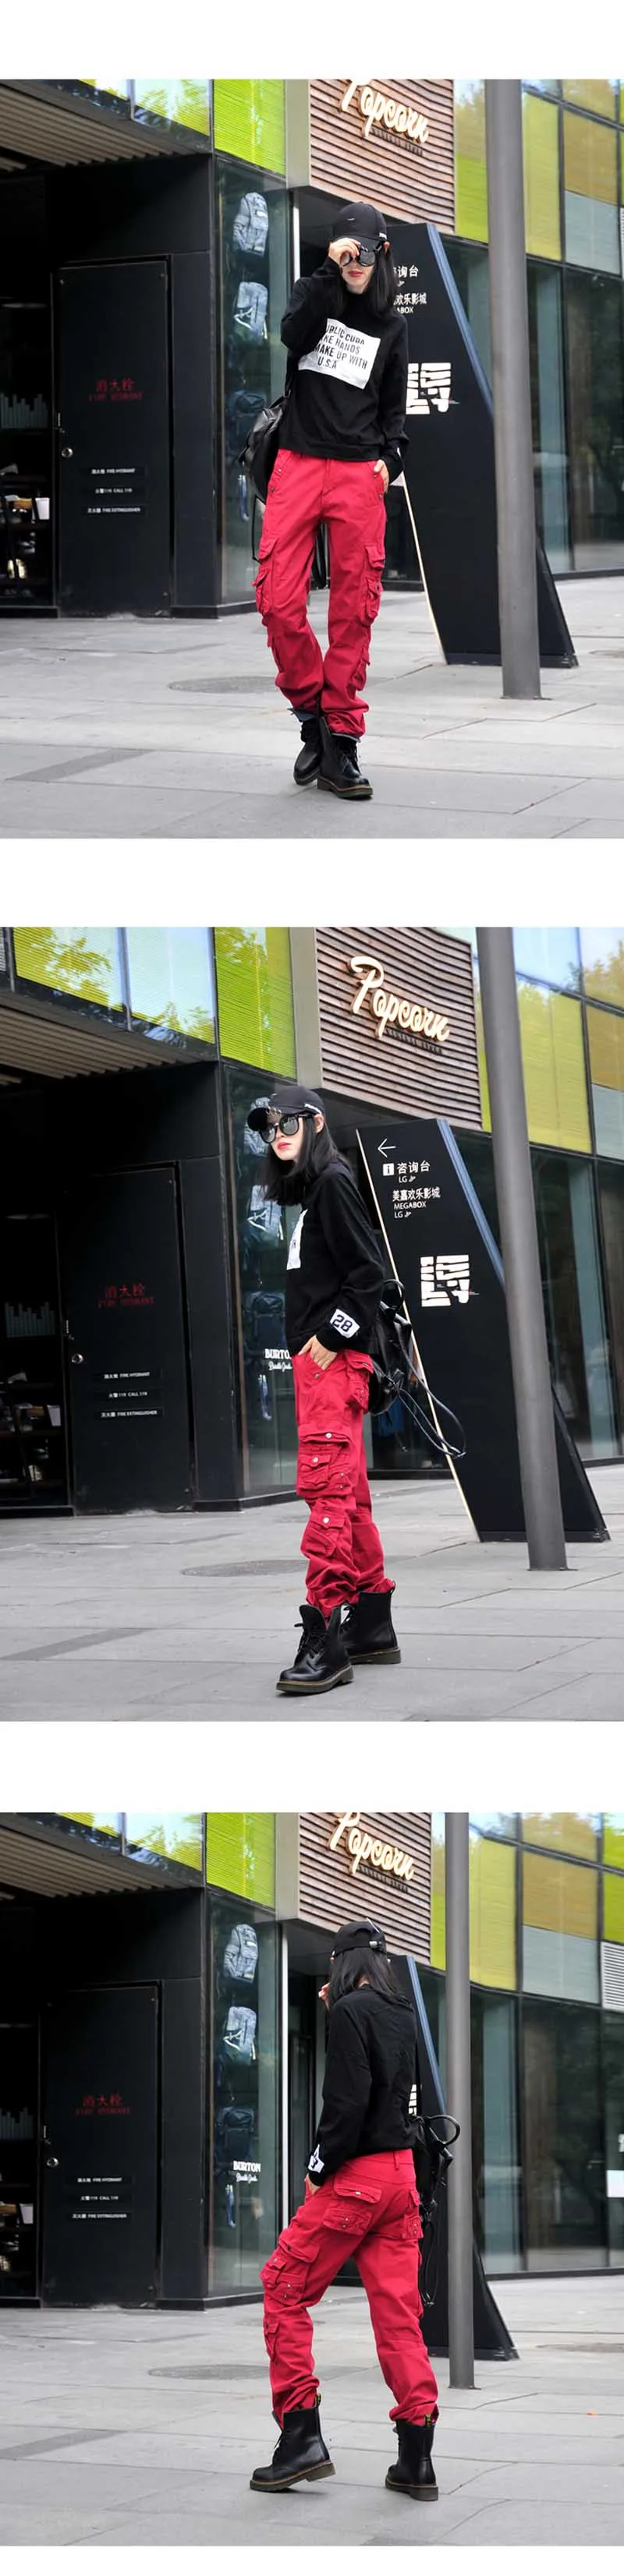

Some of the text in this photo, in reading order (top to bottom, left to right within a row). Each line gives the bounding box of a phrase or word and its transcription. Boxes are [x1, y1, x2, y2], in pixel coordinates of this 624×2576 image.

[393, 265, 419, 277] 询台
[394, 293, 427, 305] 欢乐影城
[335, 338, 361, 355] HANDS
[336, 352, 348, 361] UP
[349, 355, 368, 369] WITH
[351, 956, 450, 1041] Popcorn
[397, 1160, 431, 1175] 咨询台
[394, 1201, 427, 1210] MEGABOX
[332, 1314, 353, 1332] 28
[264, 1348, 292, 1359] BURTO
[233, 2161, 261, 2172] BURTON
